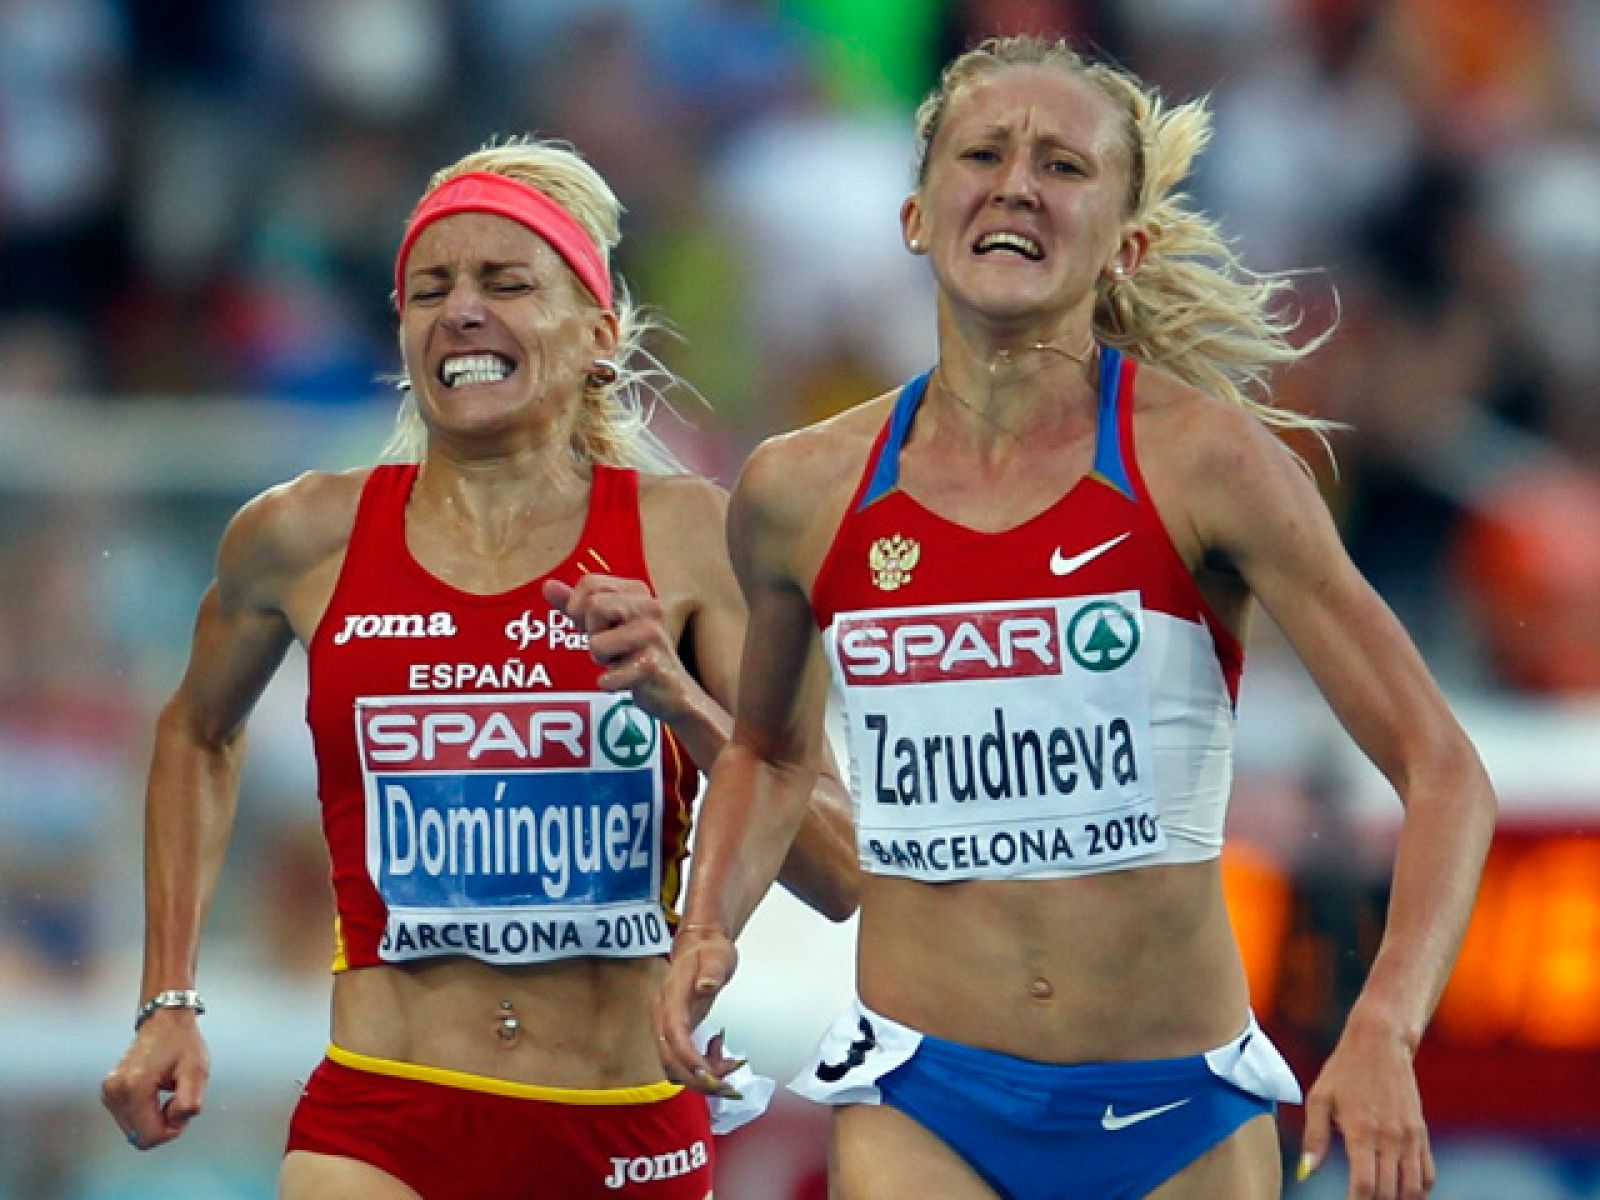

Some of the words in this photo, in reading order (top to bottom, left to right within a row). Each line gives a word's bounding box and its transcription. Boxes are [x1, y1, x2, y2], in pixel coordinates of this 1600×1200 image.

[408, 659, 553, 690] ESPAÑA
[840, 619, 1056, 677] SPAR
[366, 710, 585, 763] SPAR
[865, 706, 1138, 806] Zarudneva
[384, 781, 652, 899] Domínguez
[869, 826, 1075, 871] BARCELONA
[1083, 812, 1160, 856] 2010
[594, 911, 661, 950] 2010
[604, 1140, 708, 1189] Joma
